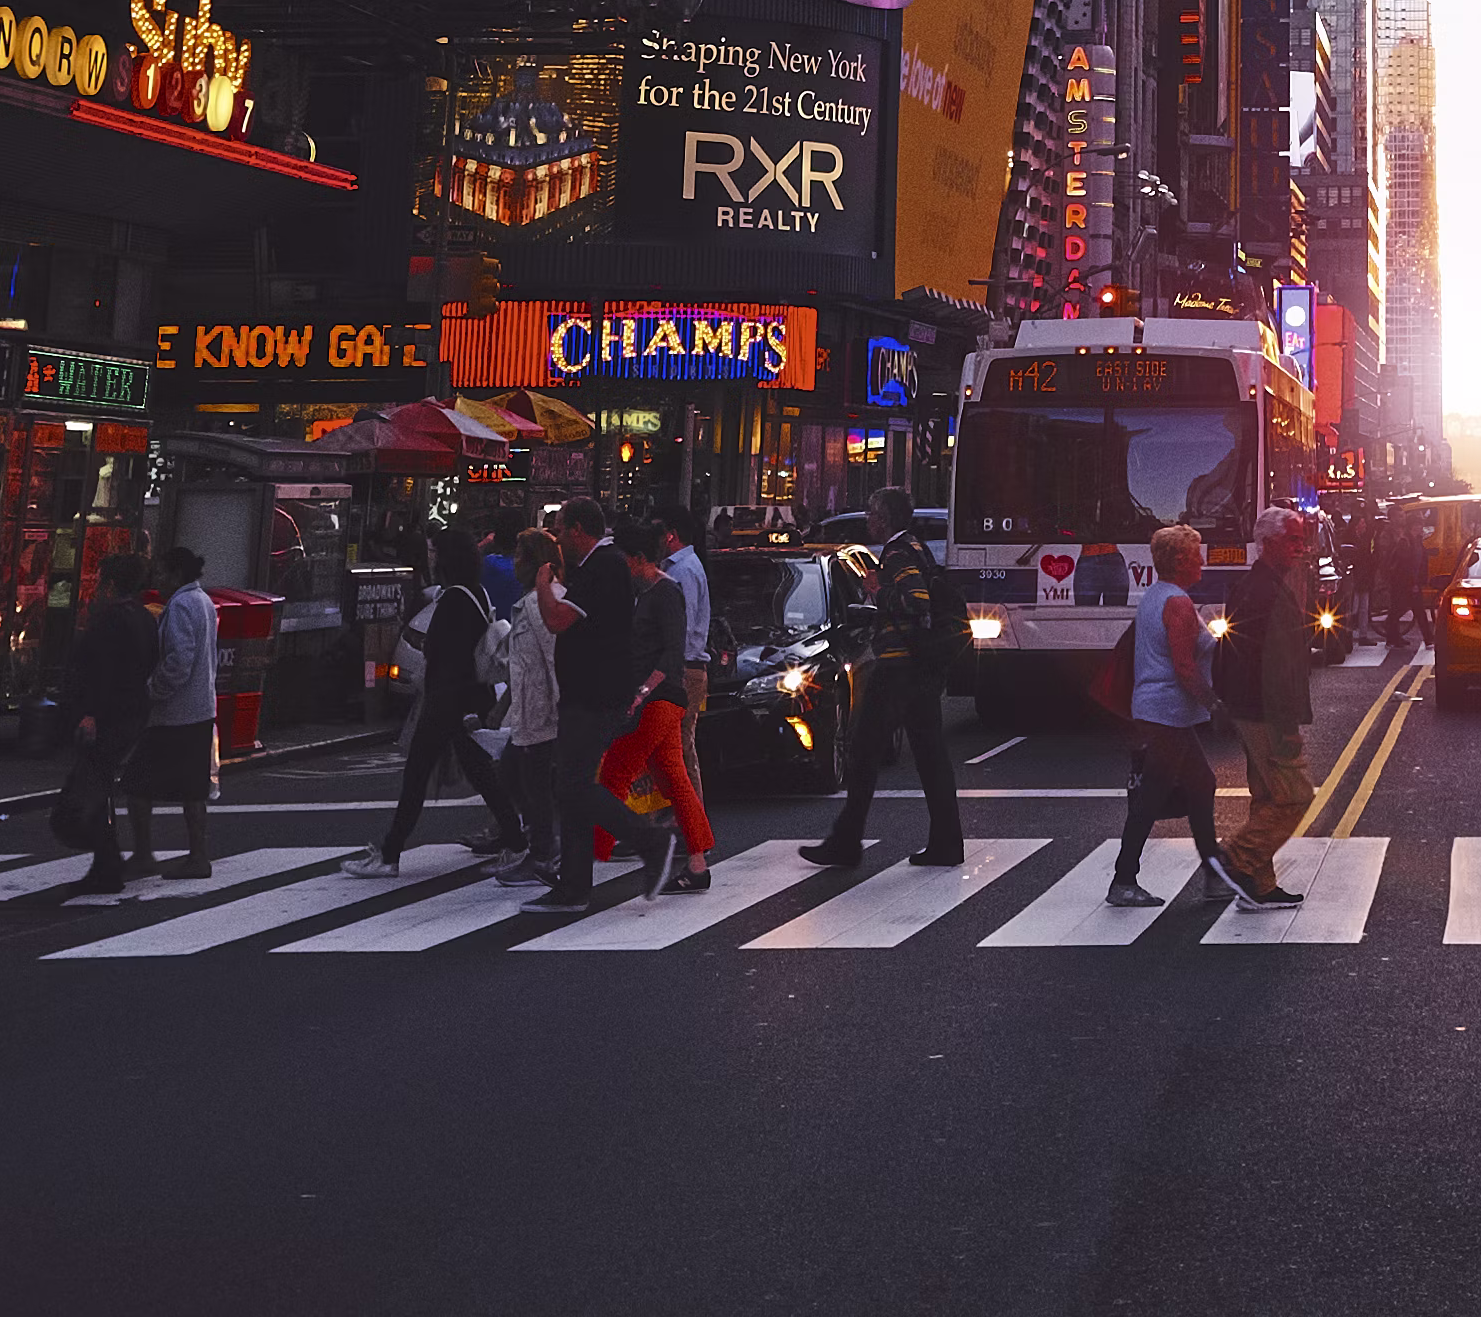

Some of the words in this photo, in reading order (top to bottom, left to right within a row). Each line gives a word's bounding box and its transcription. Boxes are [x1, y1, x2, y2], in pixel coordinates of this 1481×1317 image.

[29, 27, 42, 66] Q
[59, 36, 72, 76] R
[89, 50, 105, 90] W
[768, 41, 823, 75] New
[828, 49, 867, 82] York
[636, 75, 683, 107] for
[692, 78, 737, 111] the
[742, 84, 791, 117] 21st
[797, 90, 872, 136] Century
[944, 78, 966, 124] new
[682, 130, 844, 211] RXR
[717, 206, 819, 233] REALTY
[194, 324, 313, 368] KNOW
[328, 323, 432, 368] GAE
[550, 317, 787, 374] CHAMPS
[878, 346, 918, 399] CHAMPS
[1009, 361, 1057, 392] M42
[1096, 361, 1129, 377] EAST
[1135, 361, 1168, 376] SIDE
[358, 584, 402, 600] BROADWAY'S
[979, 569, 1006, 580] 3930
[1042, 586, 1072, 600] YMI
